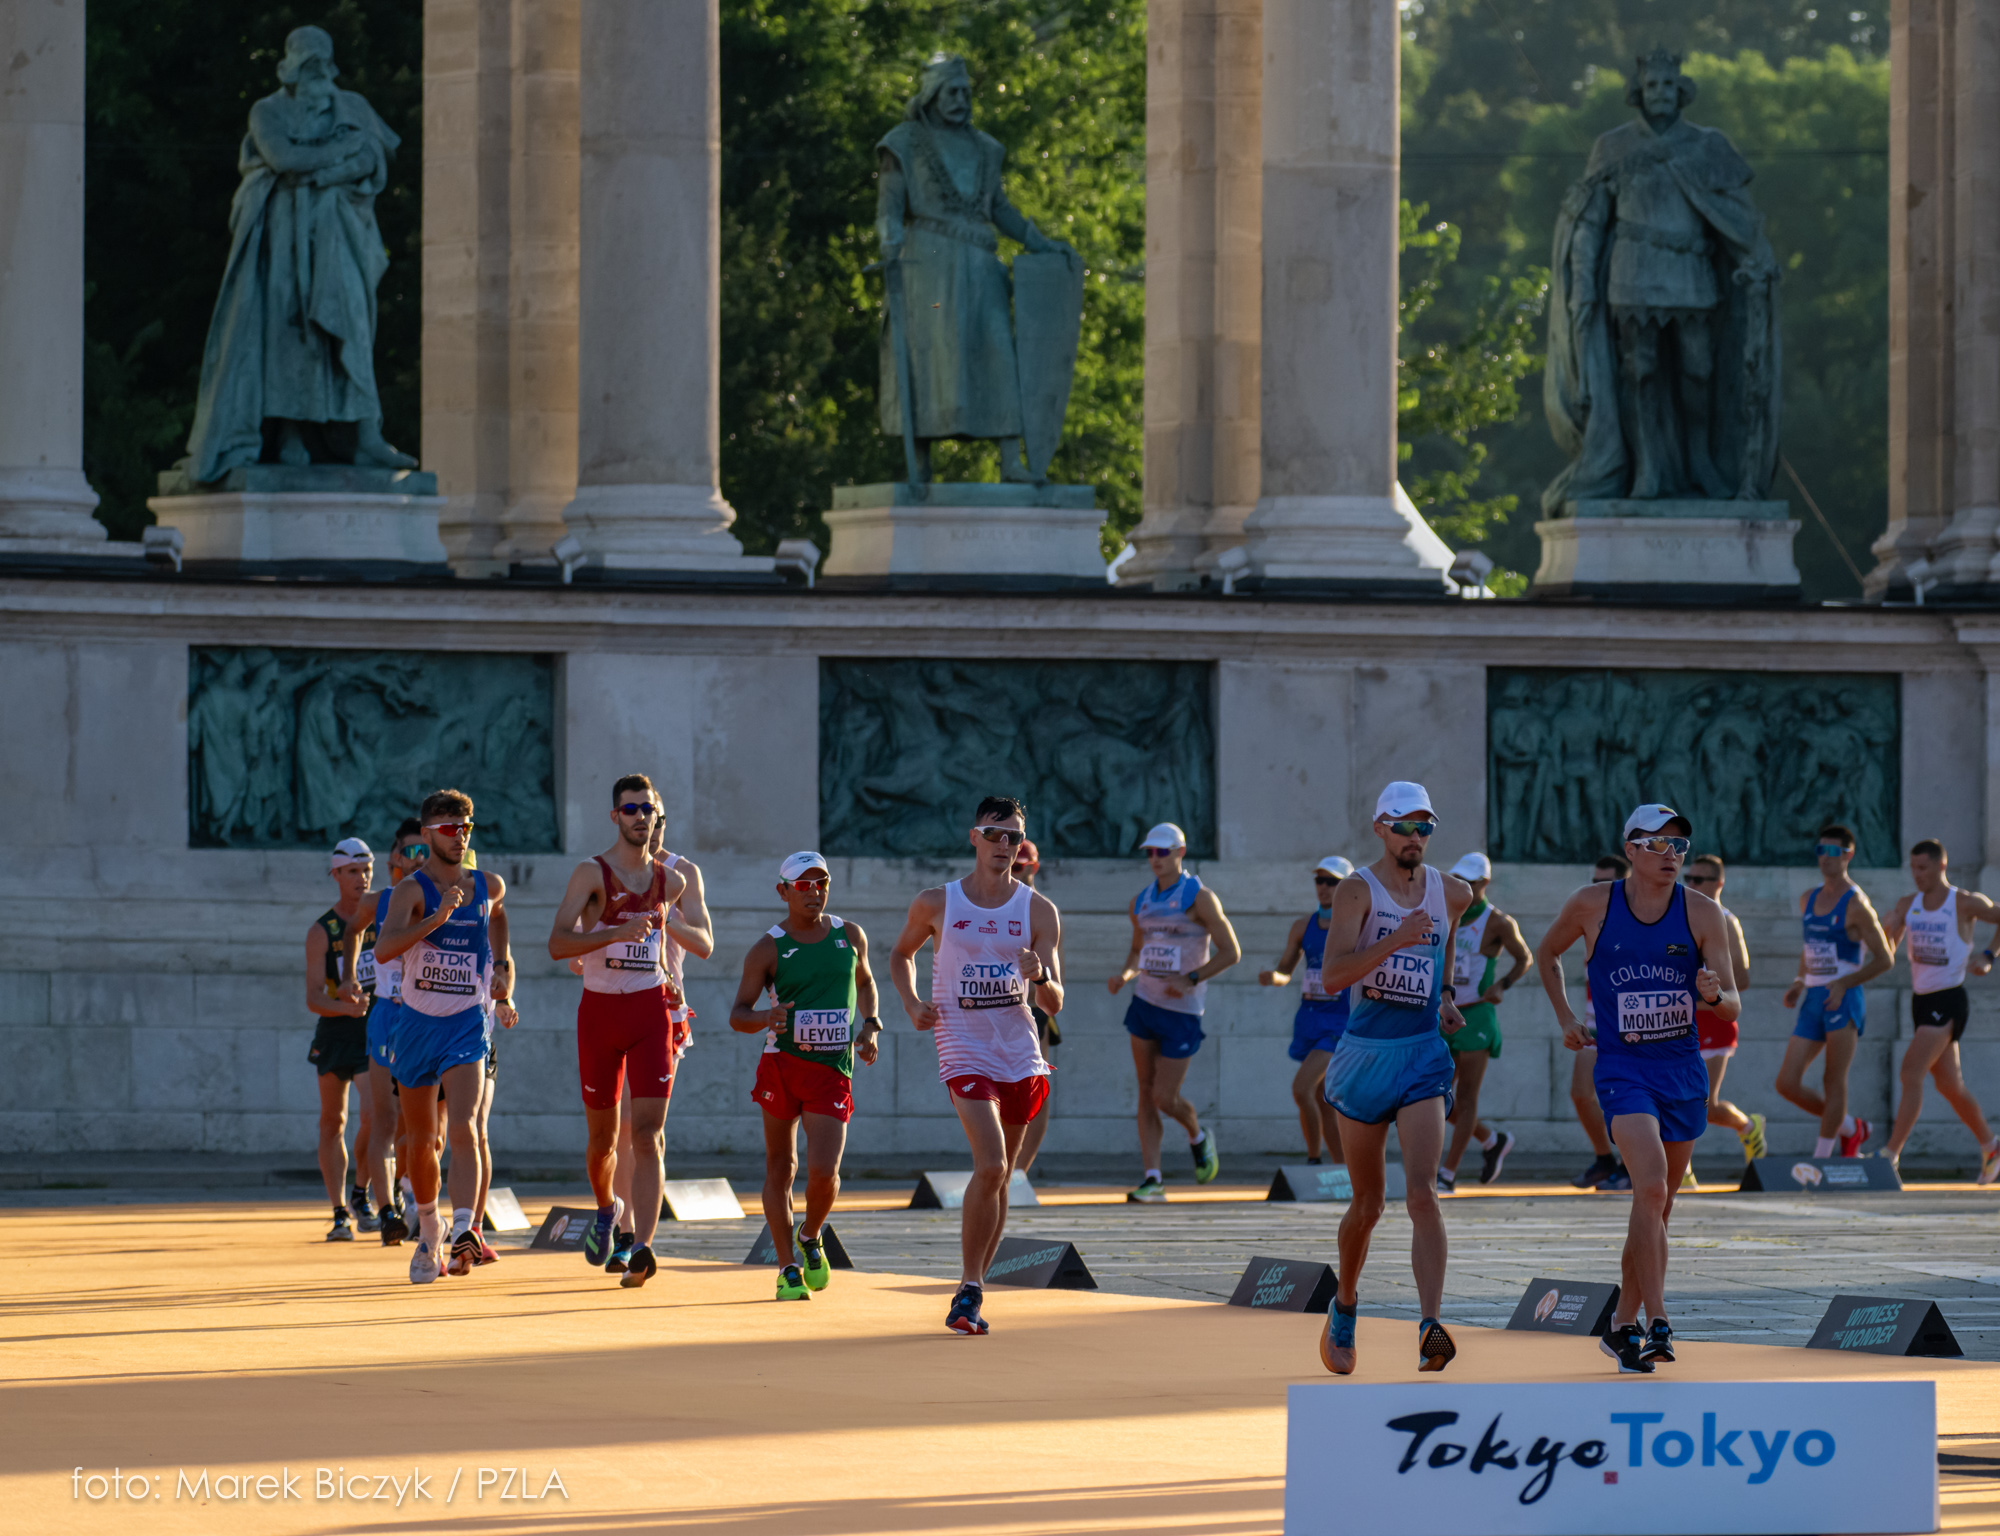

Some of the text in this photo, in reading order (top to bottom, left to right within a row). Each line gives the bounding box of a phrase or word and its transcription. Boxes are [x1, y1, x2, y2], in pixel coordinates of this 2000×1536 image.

[1377, 911, 1396, 920] CRAFT
[953, 920, 972, 930] 4F
[442, 938, 469, 946] ITALIA
[625, 945, 649, 959] TUR
[1149, 947, 1176, 957] TDK
[436, 953, 472, 968] TDK
[1390, 954, 1430, 975] TDK
[422, 966, 471, 983] ORSONI
[975, 962, 1015, 978] TDK
[1610, 964, 1687, 986] COLOMBIA
[433, 984, 464, 992] BUDAPEST
[960, 978, 1019, 996] TOMALA
[1375, 971, 1426, 994] OJALA
[1383, 993, 1422, 1004] BUDAPEST
[1639, 992, 1688, 1009] TDK
[813, 1011, 848, 1025] TDK
[1623, 1009, 1688, 1030] MONTANA
[801, 1027, 847, 1041] LEYVER
[1642, 1031, 1679, 1040] BUDAPEST
[1256, 1262, 1288, 1286] LÁSS
[1551, 1311, 1573, 1320] BUDAPEST
[1845, 1302, 1904, 1327] WITNESS
[1832, 1324, 1897, 1349] THE WONDER
[1386, 1410, 1836, 1505] Tokyo Tokyo
